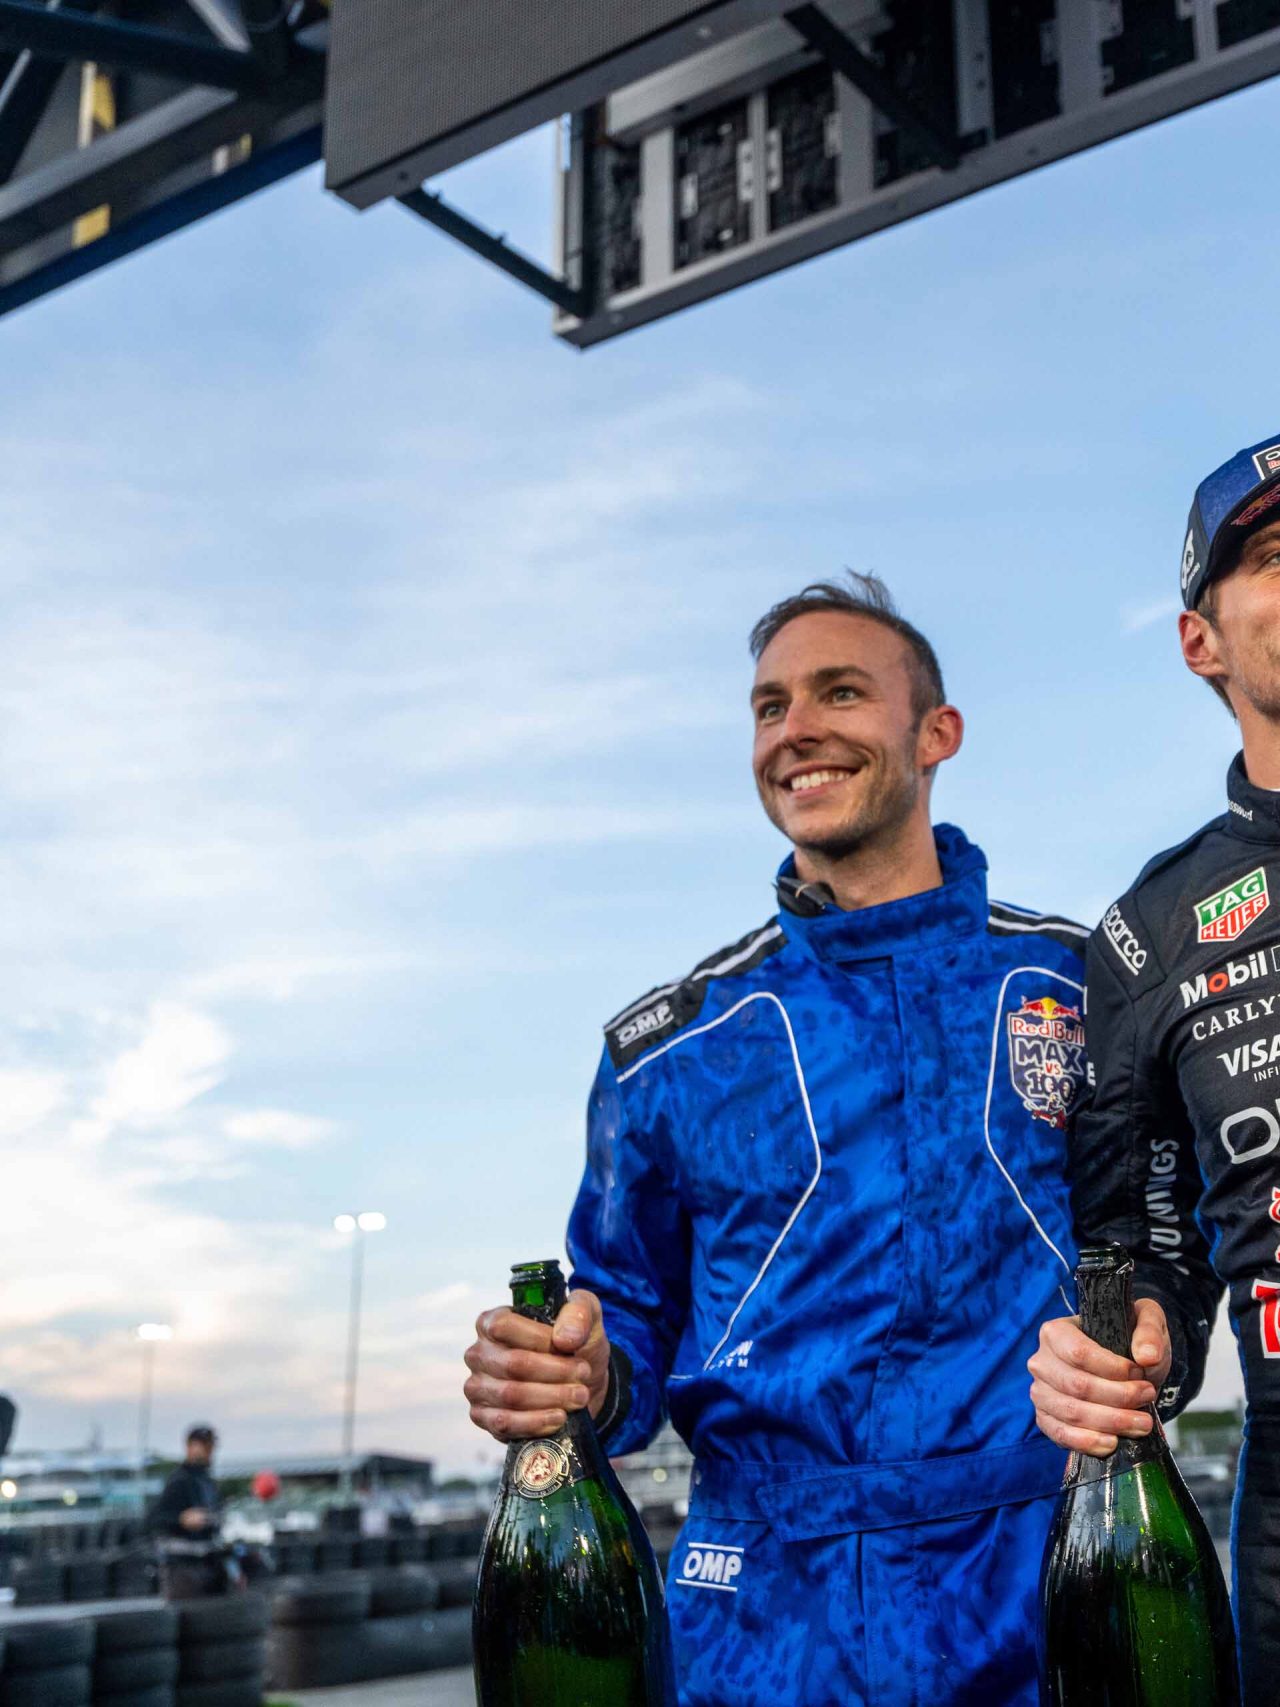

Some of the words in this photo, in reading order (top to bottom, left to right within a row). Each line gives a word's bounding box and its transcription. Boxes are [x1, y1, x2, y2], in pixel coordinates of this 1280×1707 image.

[1201, 876, 1261, 920] TAG
[1203, 896, 1265, 939] HEUER
[1179, 950, 1269, 1009] Mobil
[618, 1004, 672, 1043] OMP
[1012, 1016, 1050, 1037] Red
[1052, 1020, 1085, 1047] Bull
[1015, 1038, 1084, 1076] MAX
[683, 1550, 742, 1584] OMP
